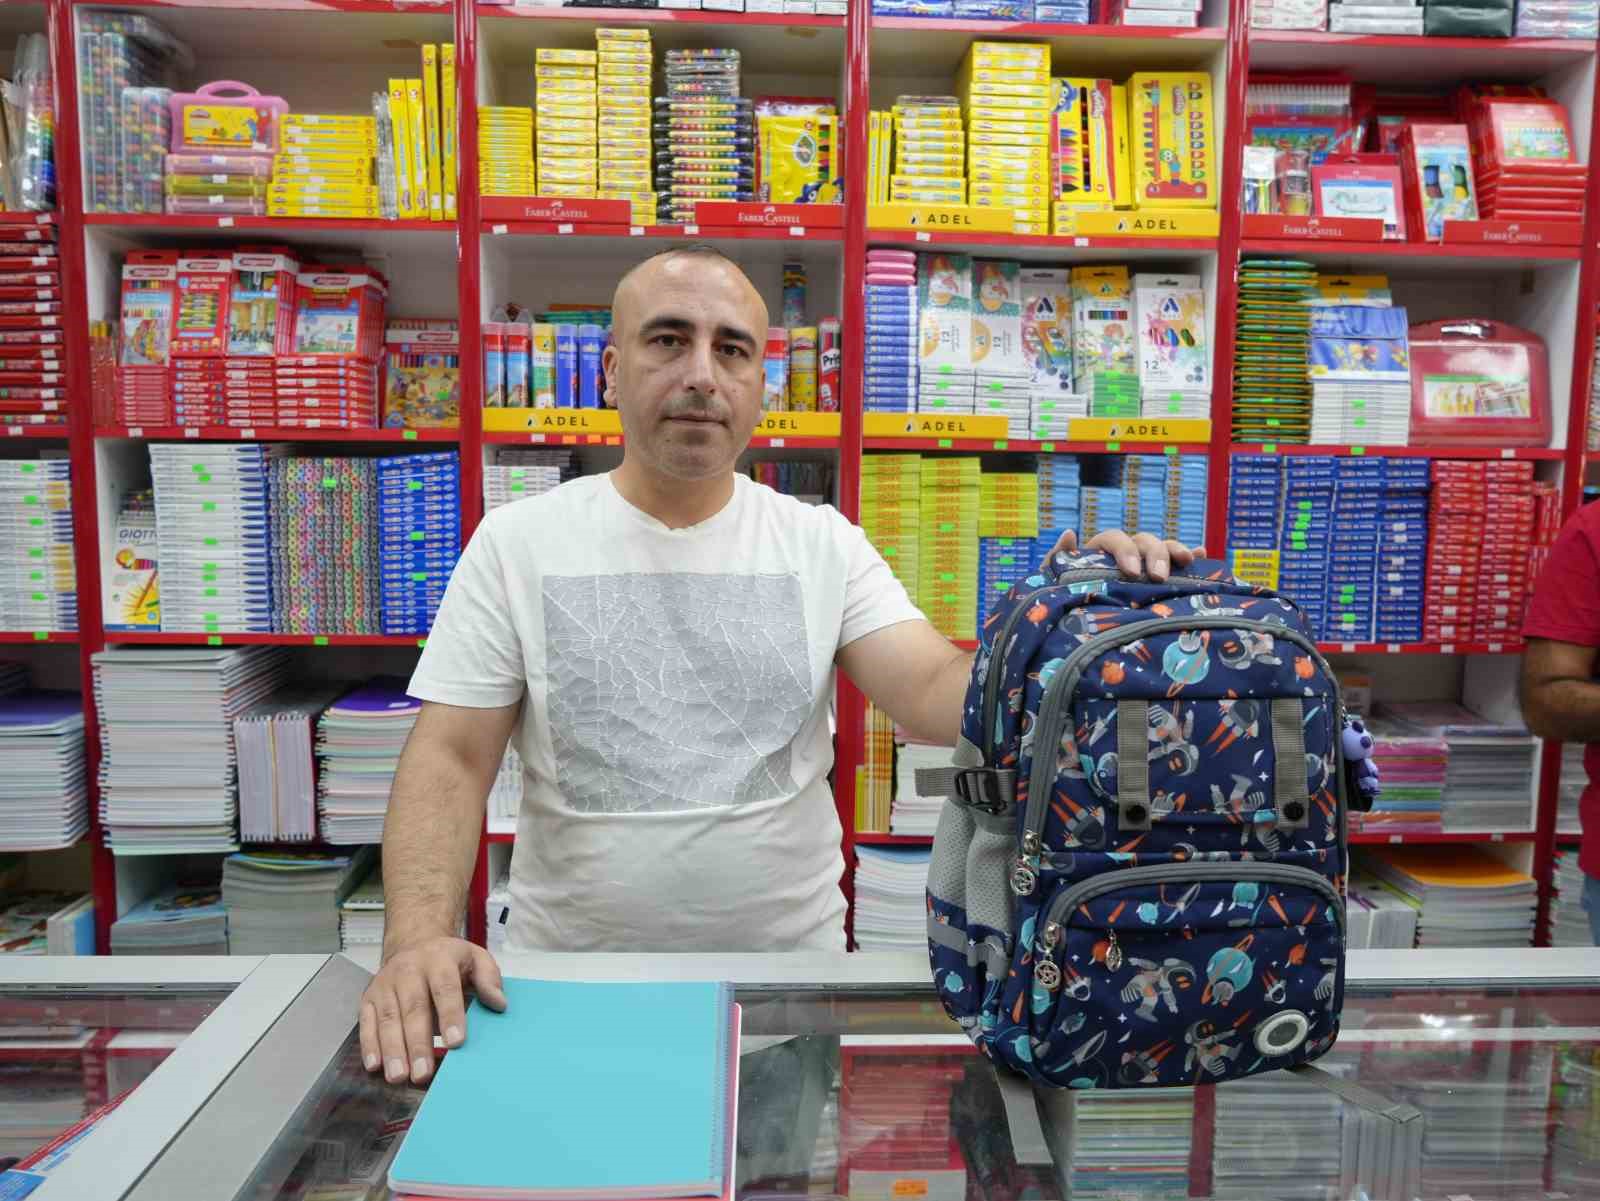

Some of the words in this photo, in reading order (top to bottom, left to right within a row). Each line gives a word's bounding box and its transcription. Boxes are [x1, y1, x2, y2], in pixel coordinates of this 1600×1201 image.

[927, 213, 972, 225] ADEL
[1134, 218, 1177, 230] ADEL
[1144, 360, 1160, 370] 12
[544, 415, 589, 426] ADEL
[922, 420, 966, 432] ADEL
[1126, 425, 1169, 436] ADEL
[119, 529, 158, 538] GIOTT
